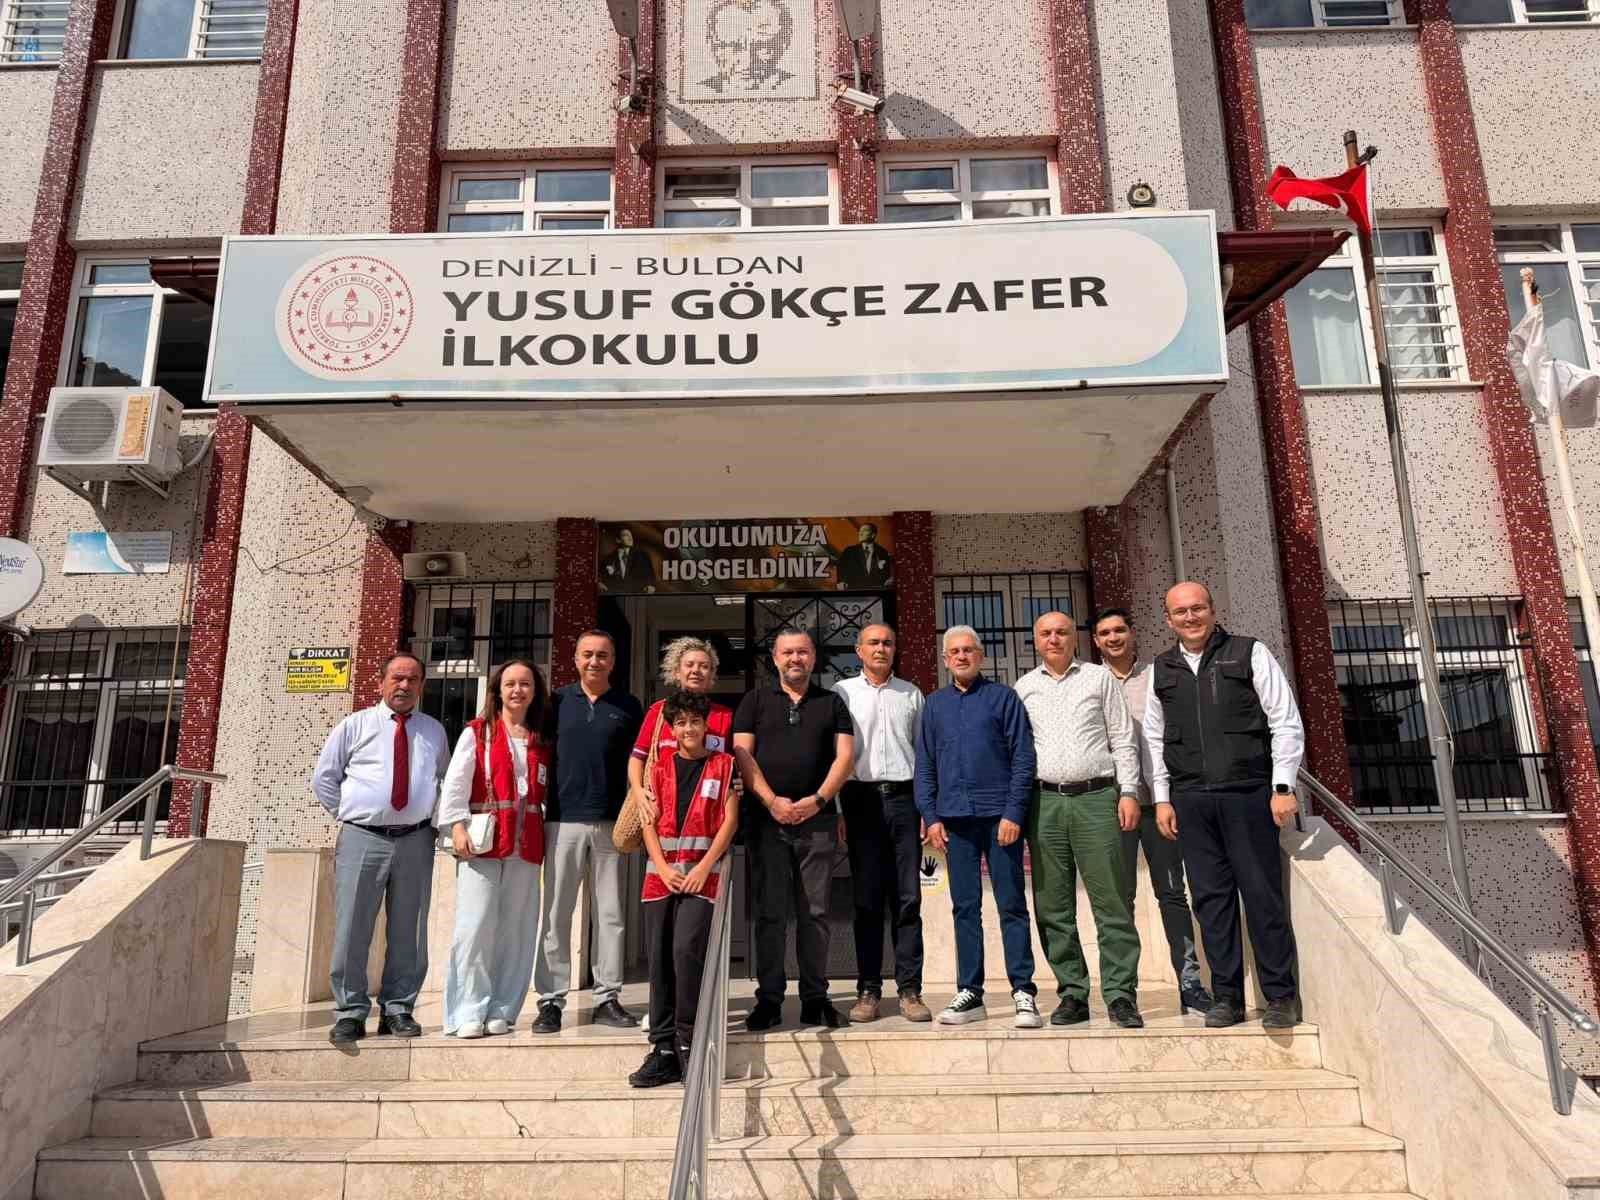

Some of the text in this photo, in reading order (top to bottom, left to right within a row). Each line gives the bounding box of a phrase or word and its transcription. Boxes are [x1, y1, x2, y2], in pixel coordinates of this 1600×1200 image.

[442, 254, 596, 278] DENİZLİ
[636, 255, 803, 276] BULDAN
[442, 276, 1109, 327] YUSUF GÖKÇE ZAFER
[442, 328, 759, 367] İLKOKULU
[663, 524, 827, 549] OKULUMUZA
[662, 552, 830, 586] HOŞGELDİNİZ
